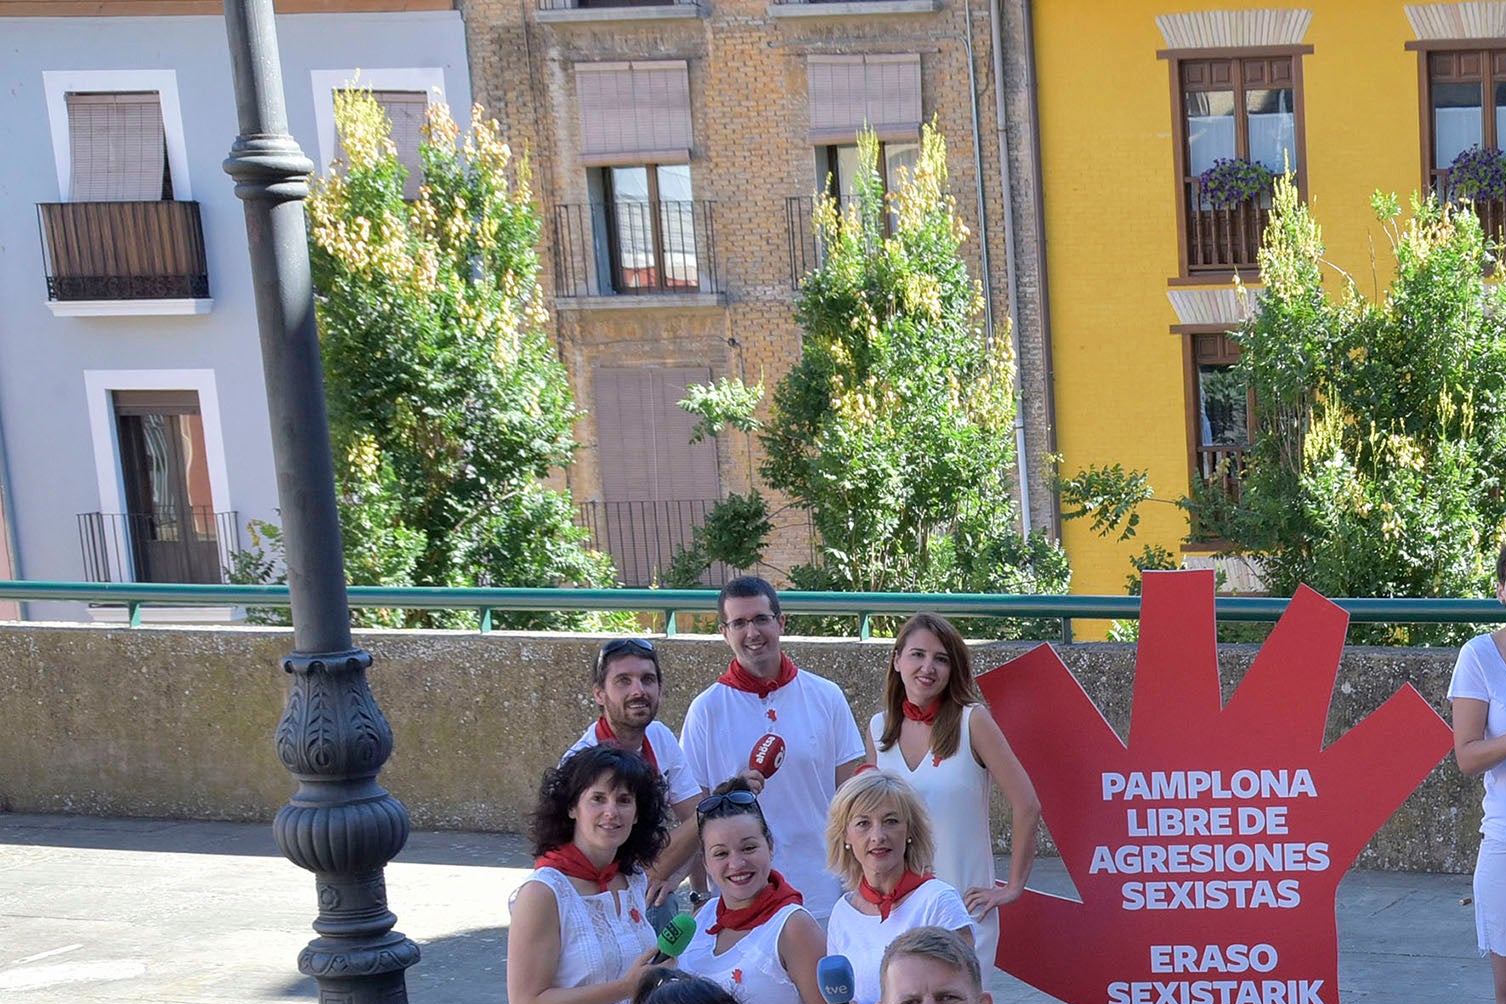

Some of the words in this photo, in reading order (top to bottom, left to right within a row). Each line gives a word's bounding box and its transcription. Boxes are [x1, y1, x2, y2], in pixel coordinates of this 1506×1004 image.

[1102, 769, 1318, 800] PAMPLONA
[1127, 808, 1233, 836] LIBRE
[1238, 807, 1289, 835] DE
[1089, 842, 1331, 874] AGRESIONES
[1122, 880, 1301, 910] SEXISTAS
[1150, 944, 1279, 973] ERASO
[825, 985, 848, 995] tve
